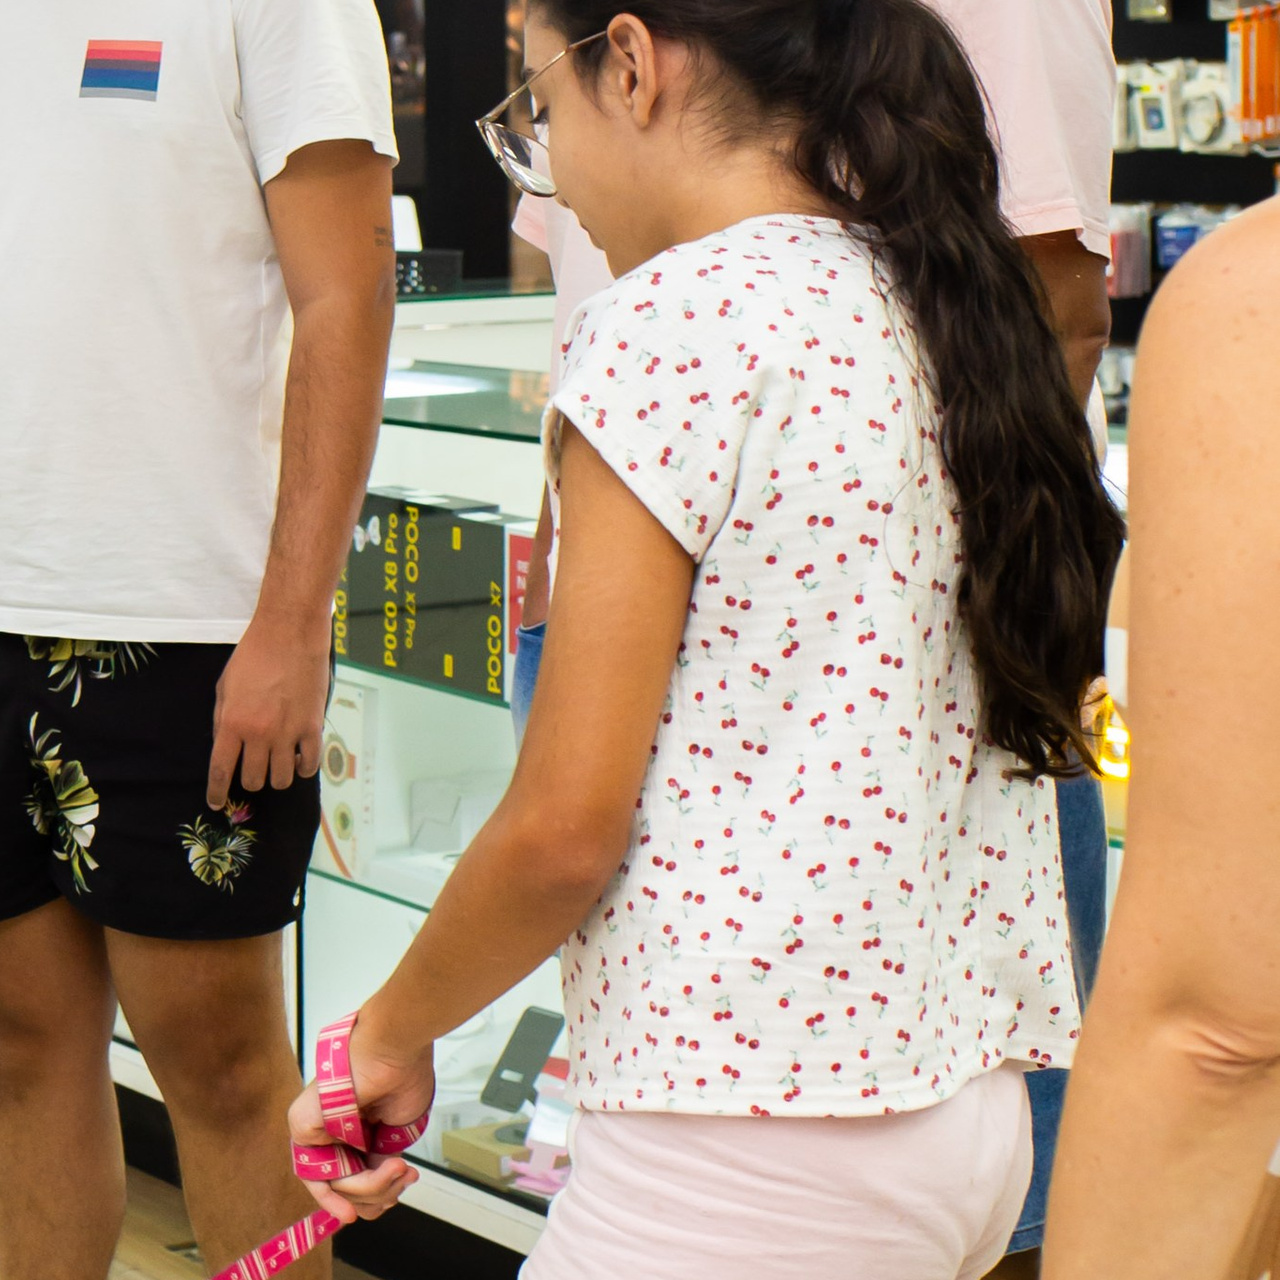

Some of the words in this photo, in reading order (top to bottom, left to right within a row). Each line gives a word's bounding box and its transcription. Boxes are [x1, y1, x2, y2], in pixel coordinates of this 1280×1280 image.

[384, 512, 399, 555] Pro
[405, 506, 420, 584] POCO
[334, 588, 348, 656] POCO
[490, 580, 503, 607] X7
[384, 600, 399, 668] POCO
[405, 618, 417, 650] Pro
[487, 614, 502, 695] POCO
